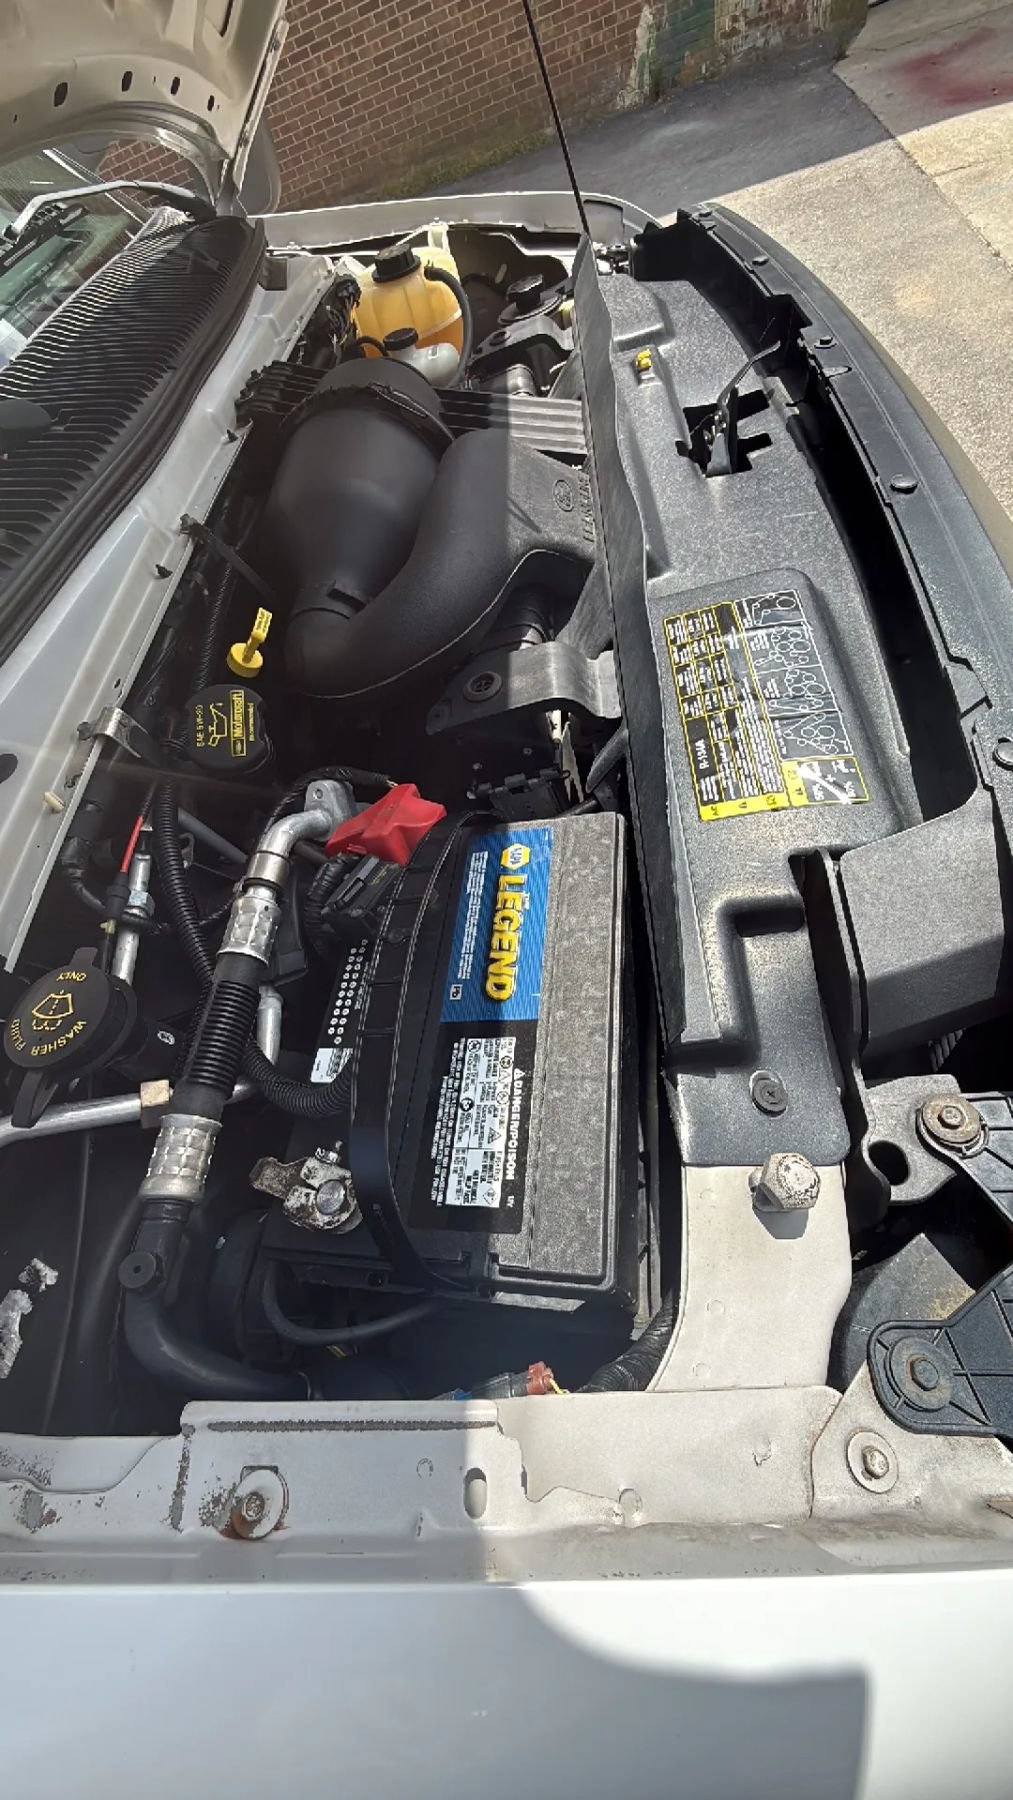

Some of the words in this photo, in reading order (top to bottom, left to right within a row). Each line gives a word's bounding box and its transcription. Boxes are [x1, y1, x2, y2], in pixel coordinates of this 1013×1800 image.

[232, 692, 243, 738] Motorcraft
[196, 731, 205, 748] SAE
[509, 847, 523, 866] NAPA
[486, 873, 528, 1000] LEGEND
[56, 970, 87, 982] ONLY
[451, 985, 461, 998] Pb
[11, 1018, 27, 1051] FLUID
[31, 1020, 87, 1056] WASHER
[506, 1079, 524, 1180] DANGER/POISON
